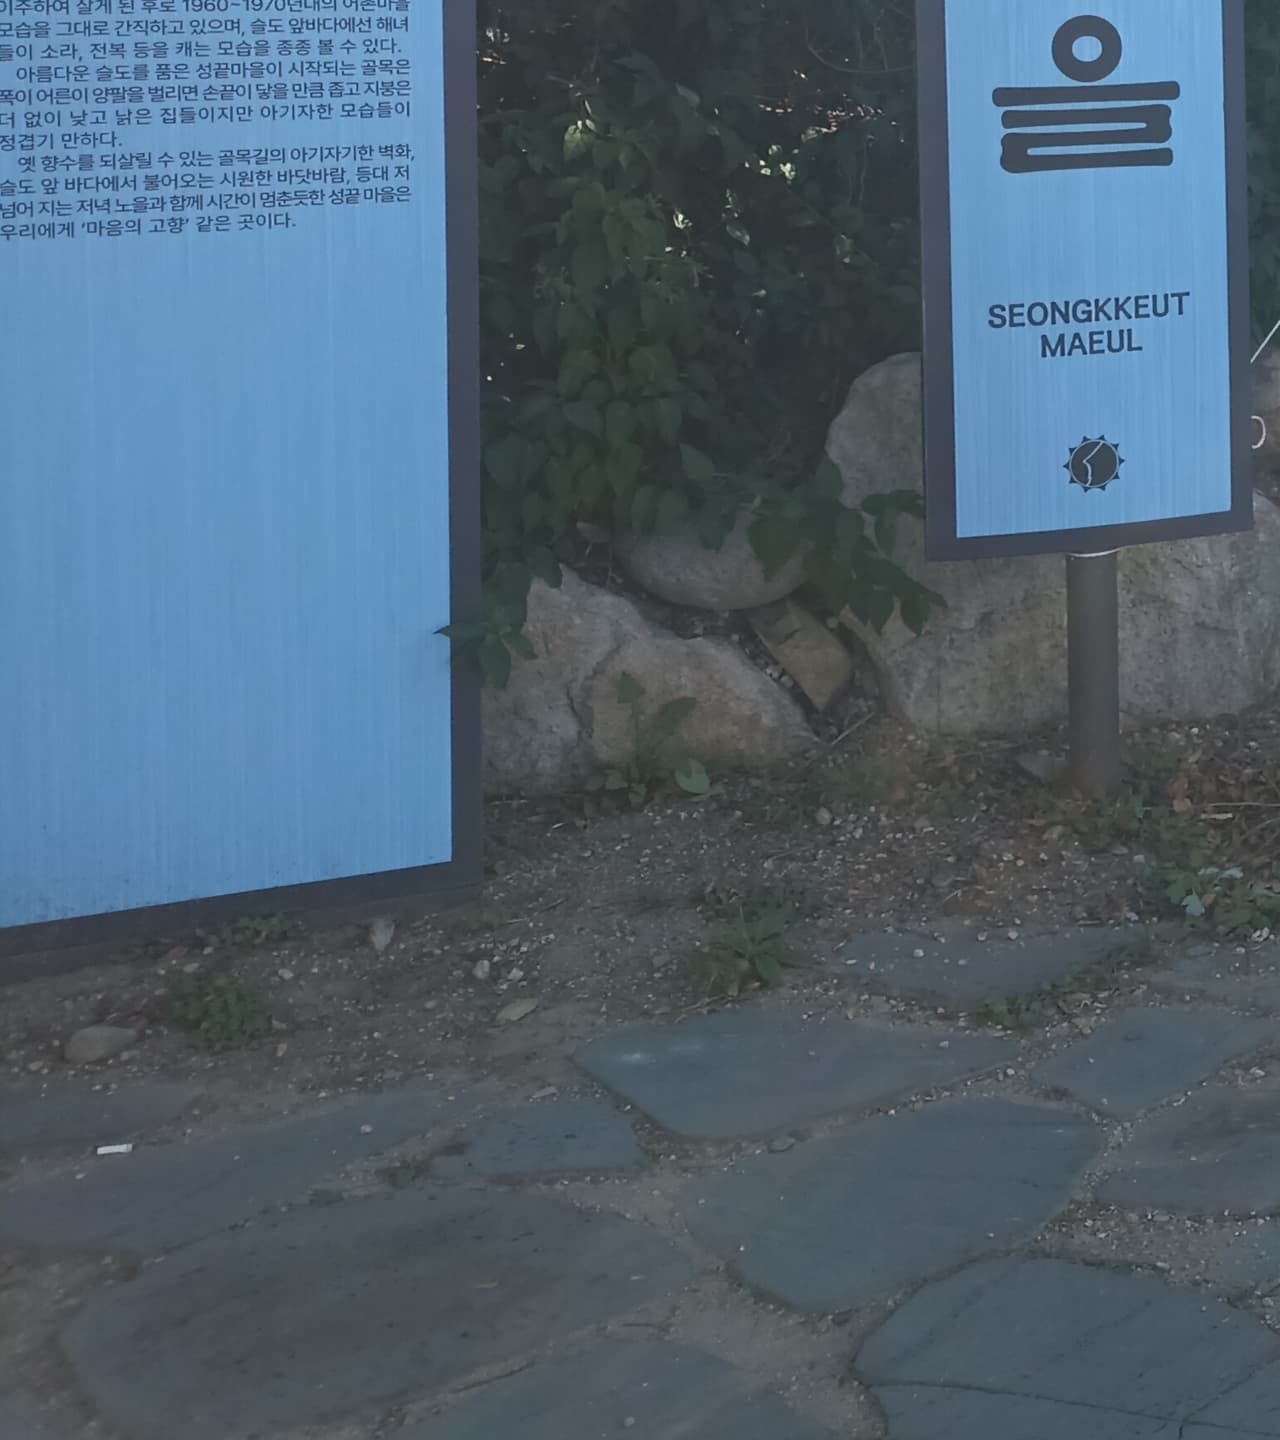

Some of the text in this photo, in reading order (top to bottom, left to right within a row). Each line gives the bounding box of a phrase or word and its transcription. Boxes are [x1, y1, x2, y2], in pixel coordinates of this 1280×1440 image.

[0, 16, 409, 39] 모습을 그대로 간직하고 있으며, 슬도 앞바다에선 해녀
[40, 43, 83, 63] 소라,
[90, 43, 127, 60] 전복
[133, 42, 170, 59] 등을
[176, 41, 212, 58] 캐는
[218, 40, 272, 57] 모습을
[277, 40, 312, 57] 종종
[318, 39, 335, 56] 볼
[340, 39, 358, 55] 수
[363, 37, 402, 55] 있다.
[16, 59, 412, 84] 아름다운 슬도를 품은 성끝마을이 시작되는 골목은
[36, 88, 89, 105] 어른이
[93, 86, 145, 105] 양팔을
[148, 85, 199, 103] 벌리면
[203, 84, 252, 102] 손끝이
[292, 82, 326, 100] 만큼
[364, 80, 412, 97] 지붕은
[24, 110, 61, 129] 없이
[70, 109, 108, 127] 낮고
[160, 105, 254, 125] 집들이지만
[340, 101, 411, 119] 모습들이
[0, 131, 123, 152] 정겹기 만하다.
[18, 144, 415, 174] 옛 향수를 되살릴 수 있는 골목길의 아기자기한 벽화,
[0, 165, 410, 197] 슬도 앞 바다에서 불어오는 시원한 바닷바람, 등대 저
[0, 201, 34, 220] 넘어
[38, 200, 73, 217] 지는
[77, 198, 111, 216] 저녁
[115, 196, 167, 215] 노을과
[169, 195, 204, 212] 함께
[207, 192, 256, 211] 시간이
[328, 188, 361, 206] 성끝
[364, 186, 412, 204] 마을은
[0, 221, 75, 241] 우리에게
[196, 216, 232, 233] 같은
[238, 212, 297, 231] 곳이다.
[988, 291, 1191, 329] SEONGKKEUT
[1040, 328, 1143, 358] MAEUL
